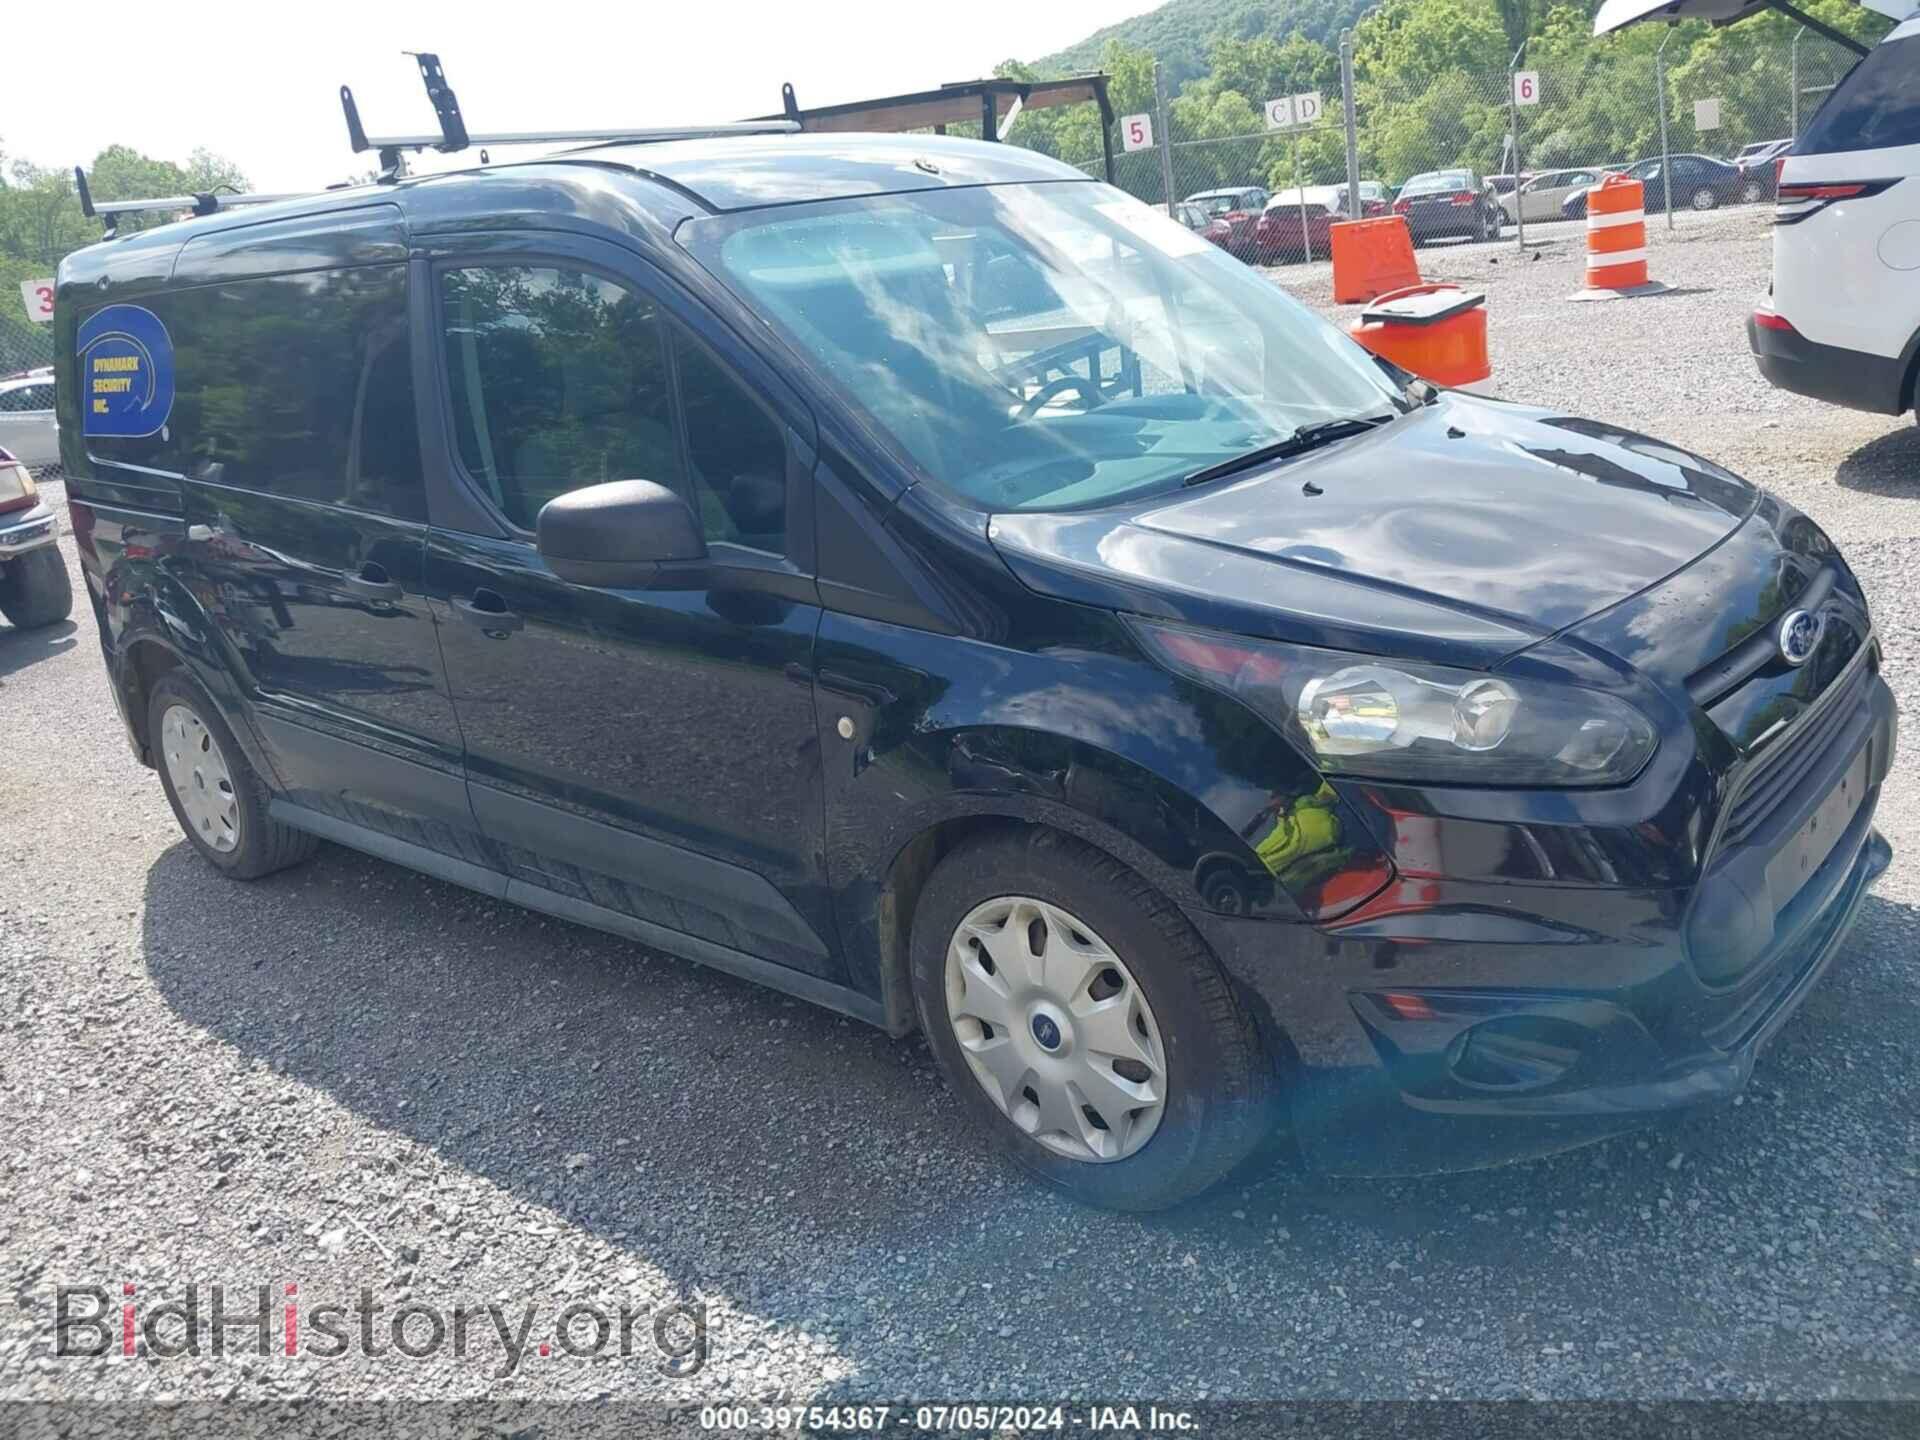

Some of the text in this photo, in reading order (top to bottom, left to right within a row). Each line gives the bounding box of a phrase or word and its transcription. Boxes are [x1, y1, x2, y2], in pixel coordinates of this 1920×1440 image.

[1521, 78, 1533, 99] 6
[1271, 103, 1286, 124] C
[1301, 99, 1316, 118] D
[1130, 122, 1144, 144] 5
[36, 287, 55, 312] 3
[93, 356, 139, 372] DYNAMARK
[93, 377, 131, 393] SECURITY
